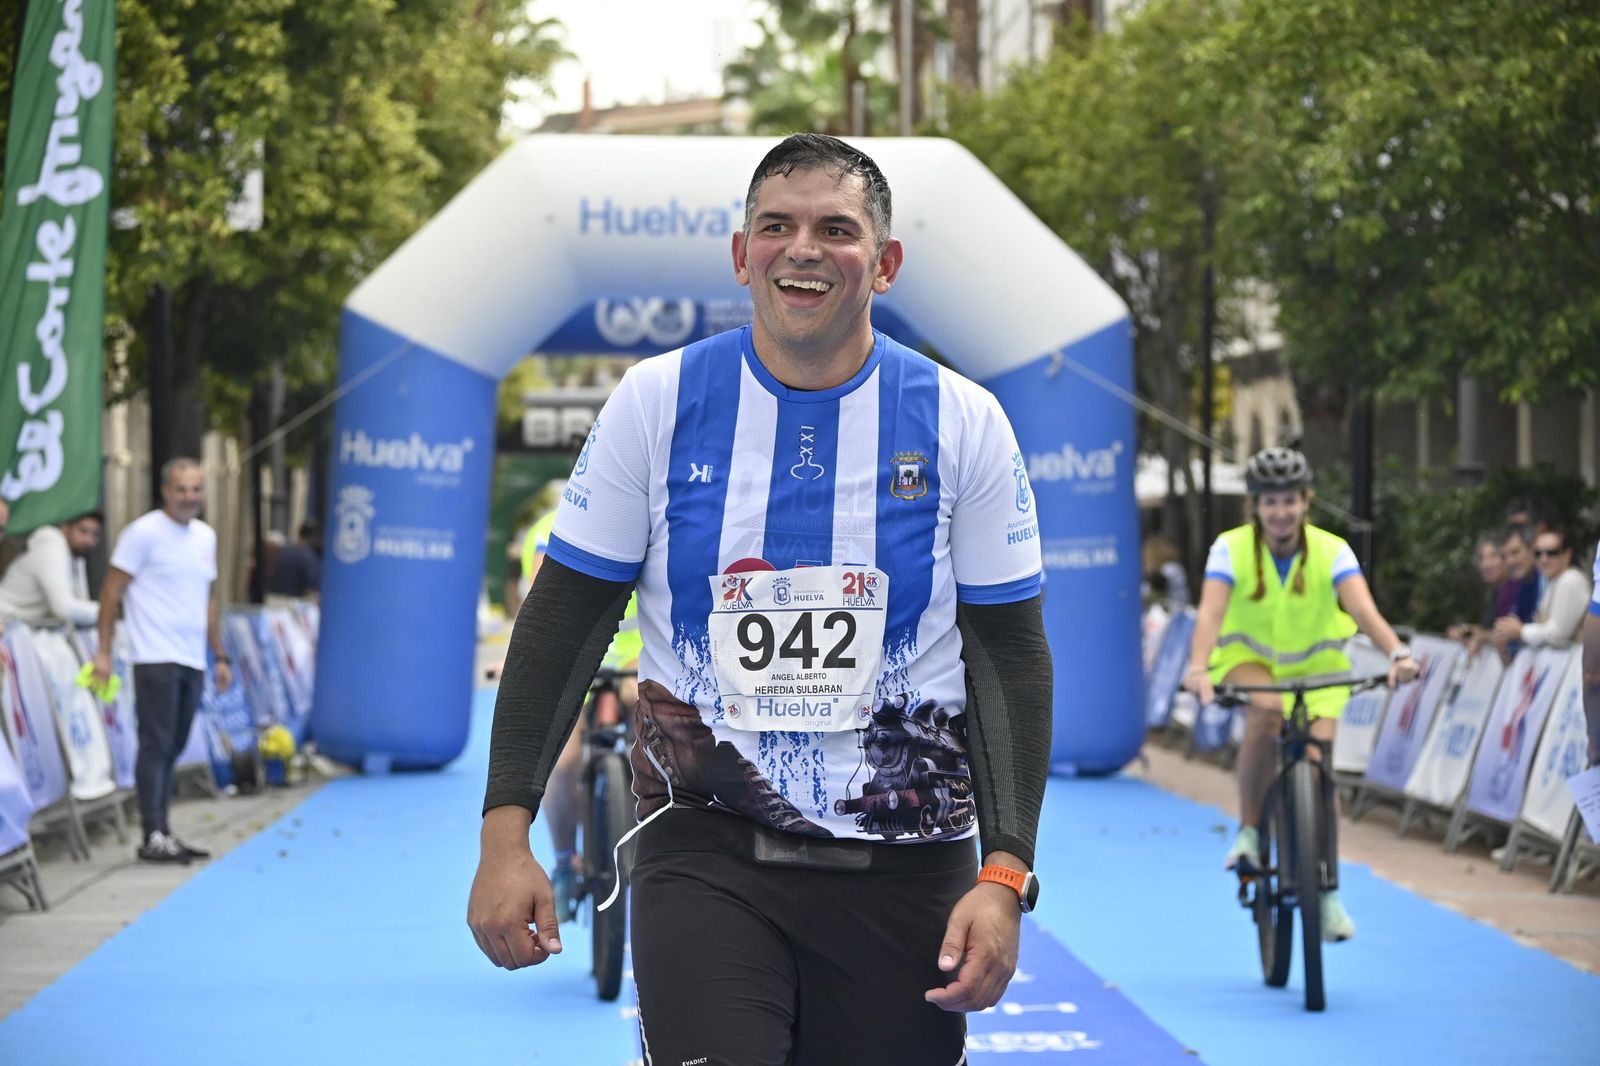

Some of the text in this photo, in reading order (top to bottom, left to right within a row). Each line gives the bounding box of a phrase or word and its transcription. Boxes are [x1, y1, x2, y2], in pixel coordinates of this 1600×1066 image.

[578, 195, 731, 237] Huelva
[17, 214, 76, 413] Corte
[339, 428, 464, 473] Huelva
[720, 600, 754, 609] HUELVA
[842, 597, 875, 606] HUELVA
[736, 611, 857, 671] 942
[771, 672, 827, 681] ANGEL ALBERTO
[754, 684, 843, 695] HEREDIA SULBARAN
[756, 697, 832, 717] Huelva
[804, 719, 832, 727] original
[682, 1057, 708, 1066] EVADICT
